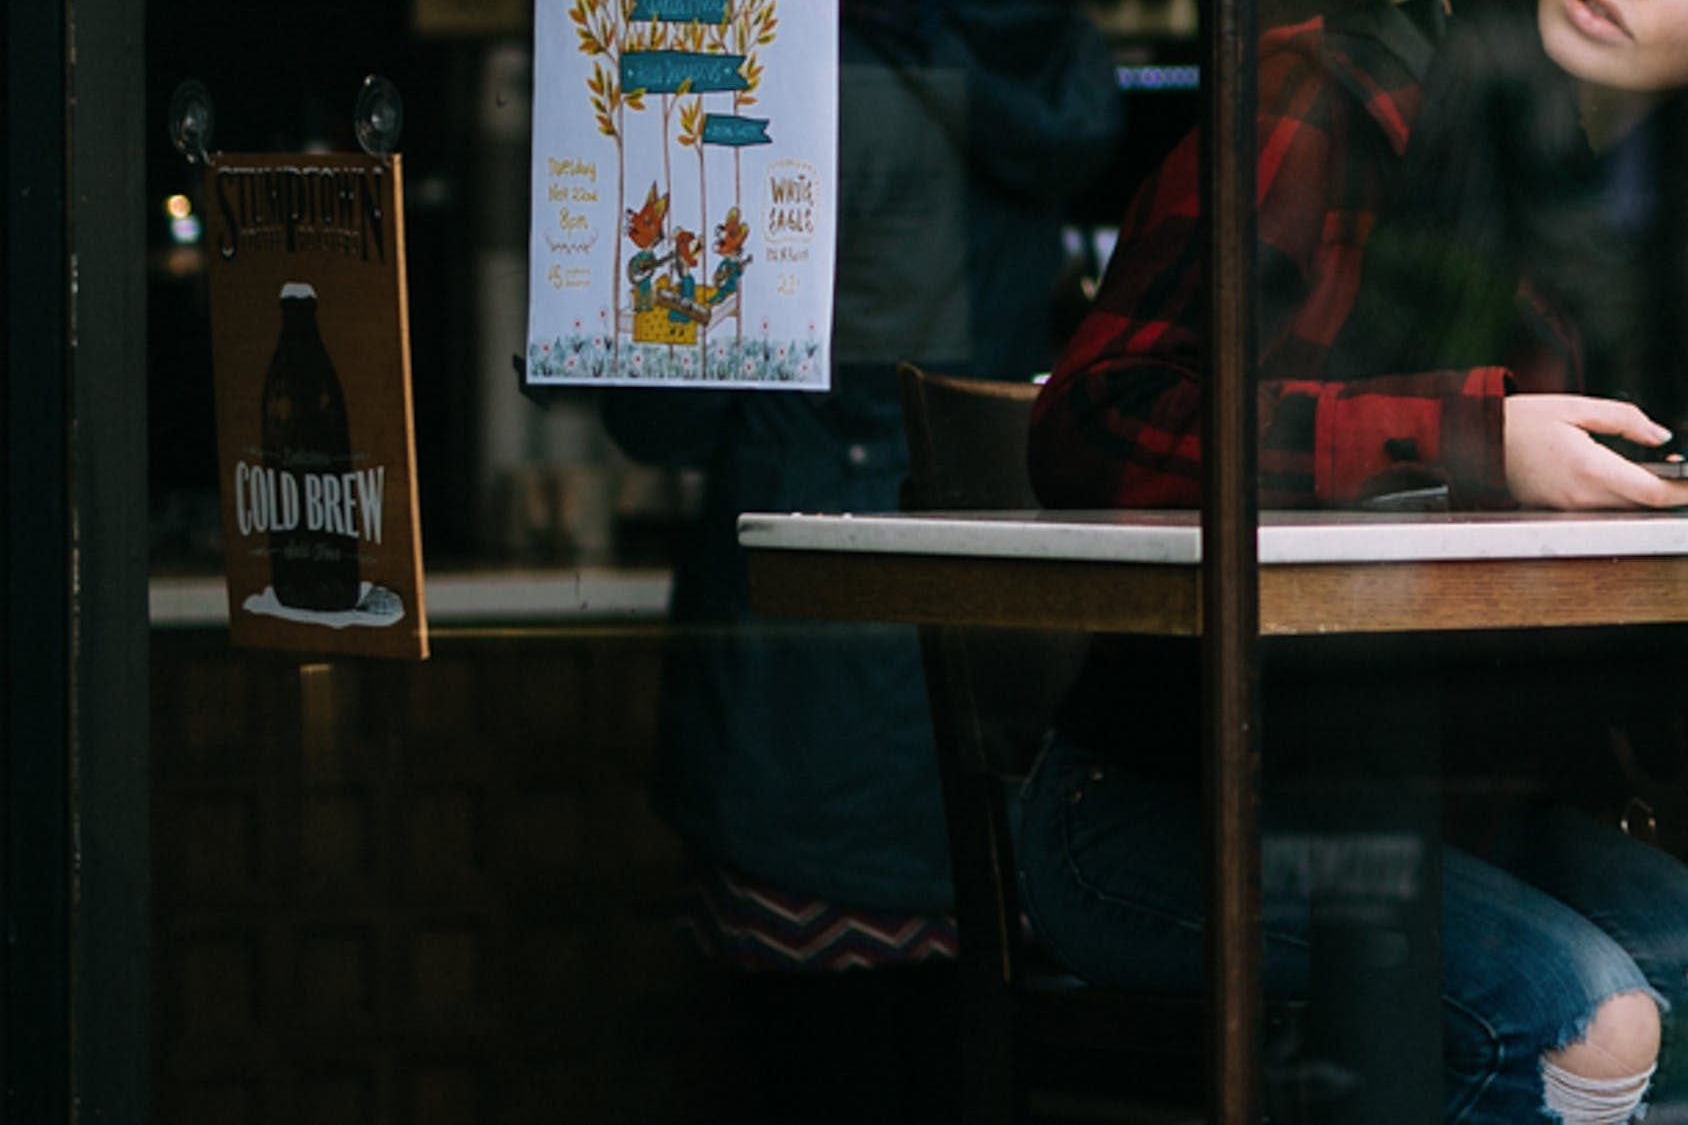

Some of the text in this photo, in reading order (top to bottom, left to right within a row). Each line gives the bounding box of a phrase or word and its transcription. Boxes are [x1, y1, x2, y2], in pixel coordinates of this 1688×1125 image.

[215, 165, 386, 263] STUMPTOWN
[235, 460, 385, 546] COLD BREW
